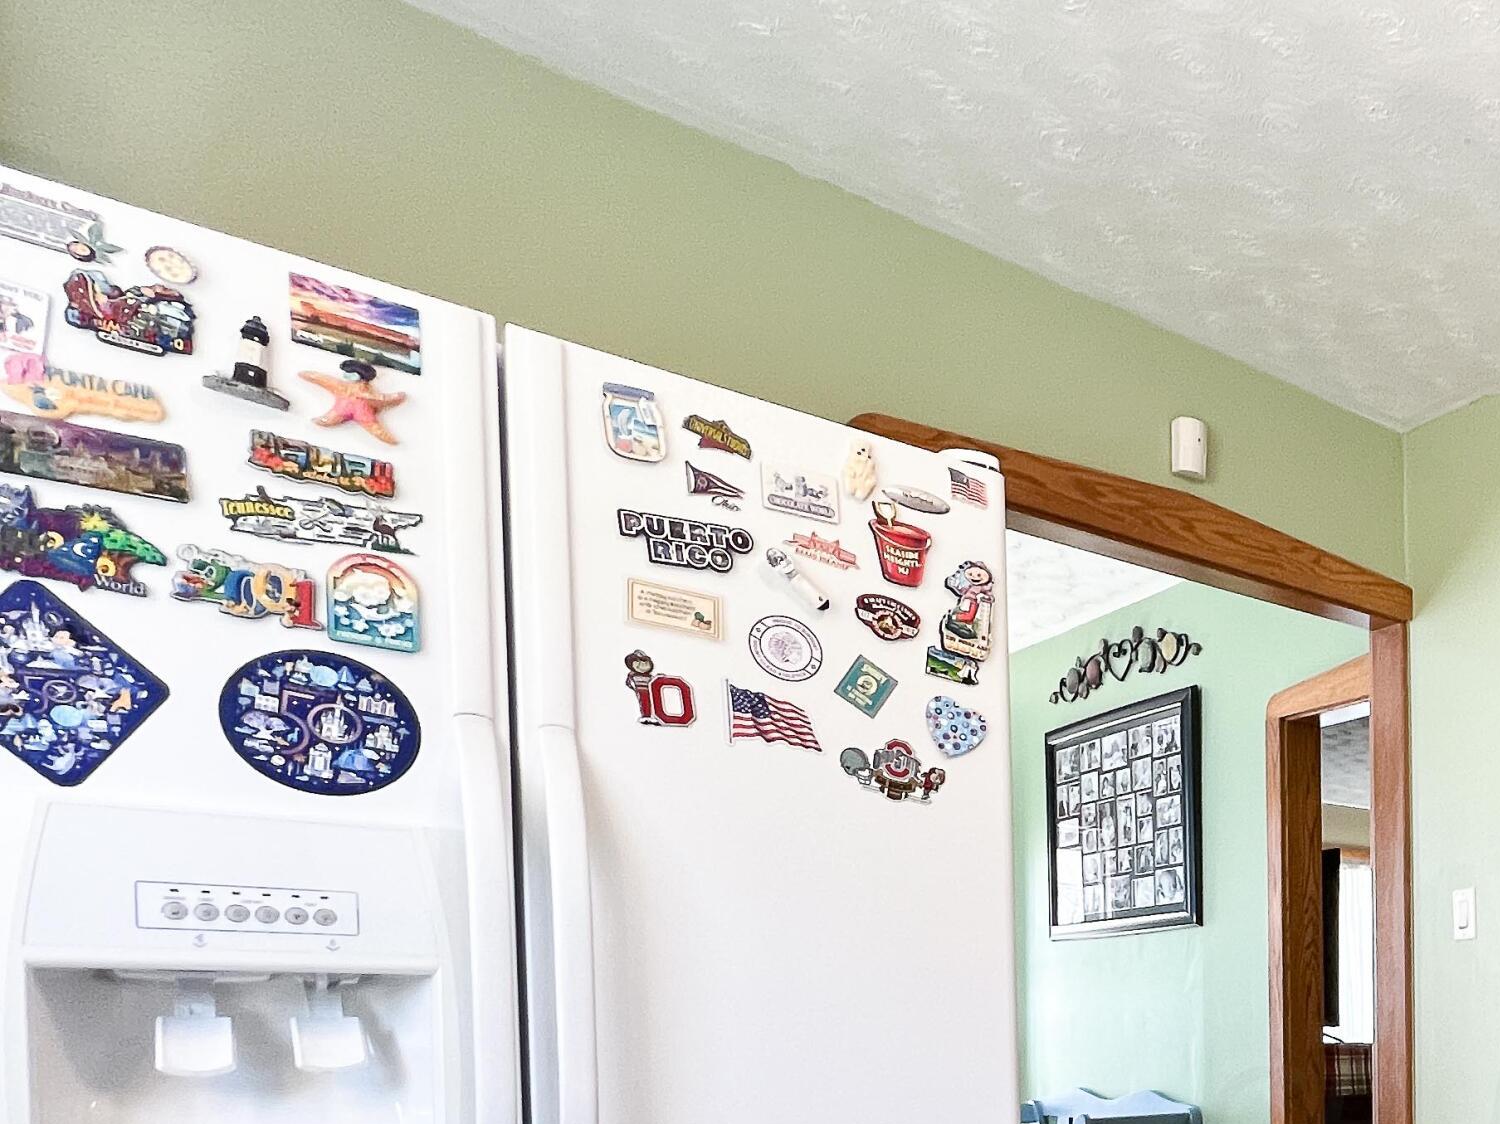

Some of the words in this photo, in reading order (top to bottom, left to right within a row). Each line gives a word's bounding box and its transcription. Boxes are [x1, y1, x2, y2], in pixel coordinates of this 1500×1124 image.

[46, 365, 108, 393] PUNTA
[620, 510, 752, 552] PUERTO
[650, 539, 732, 571] RICO
[93, 573, 146, 596] World
